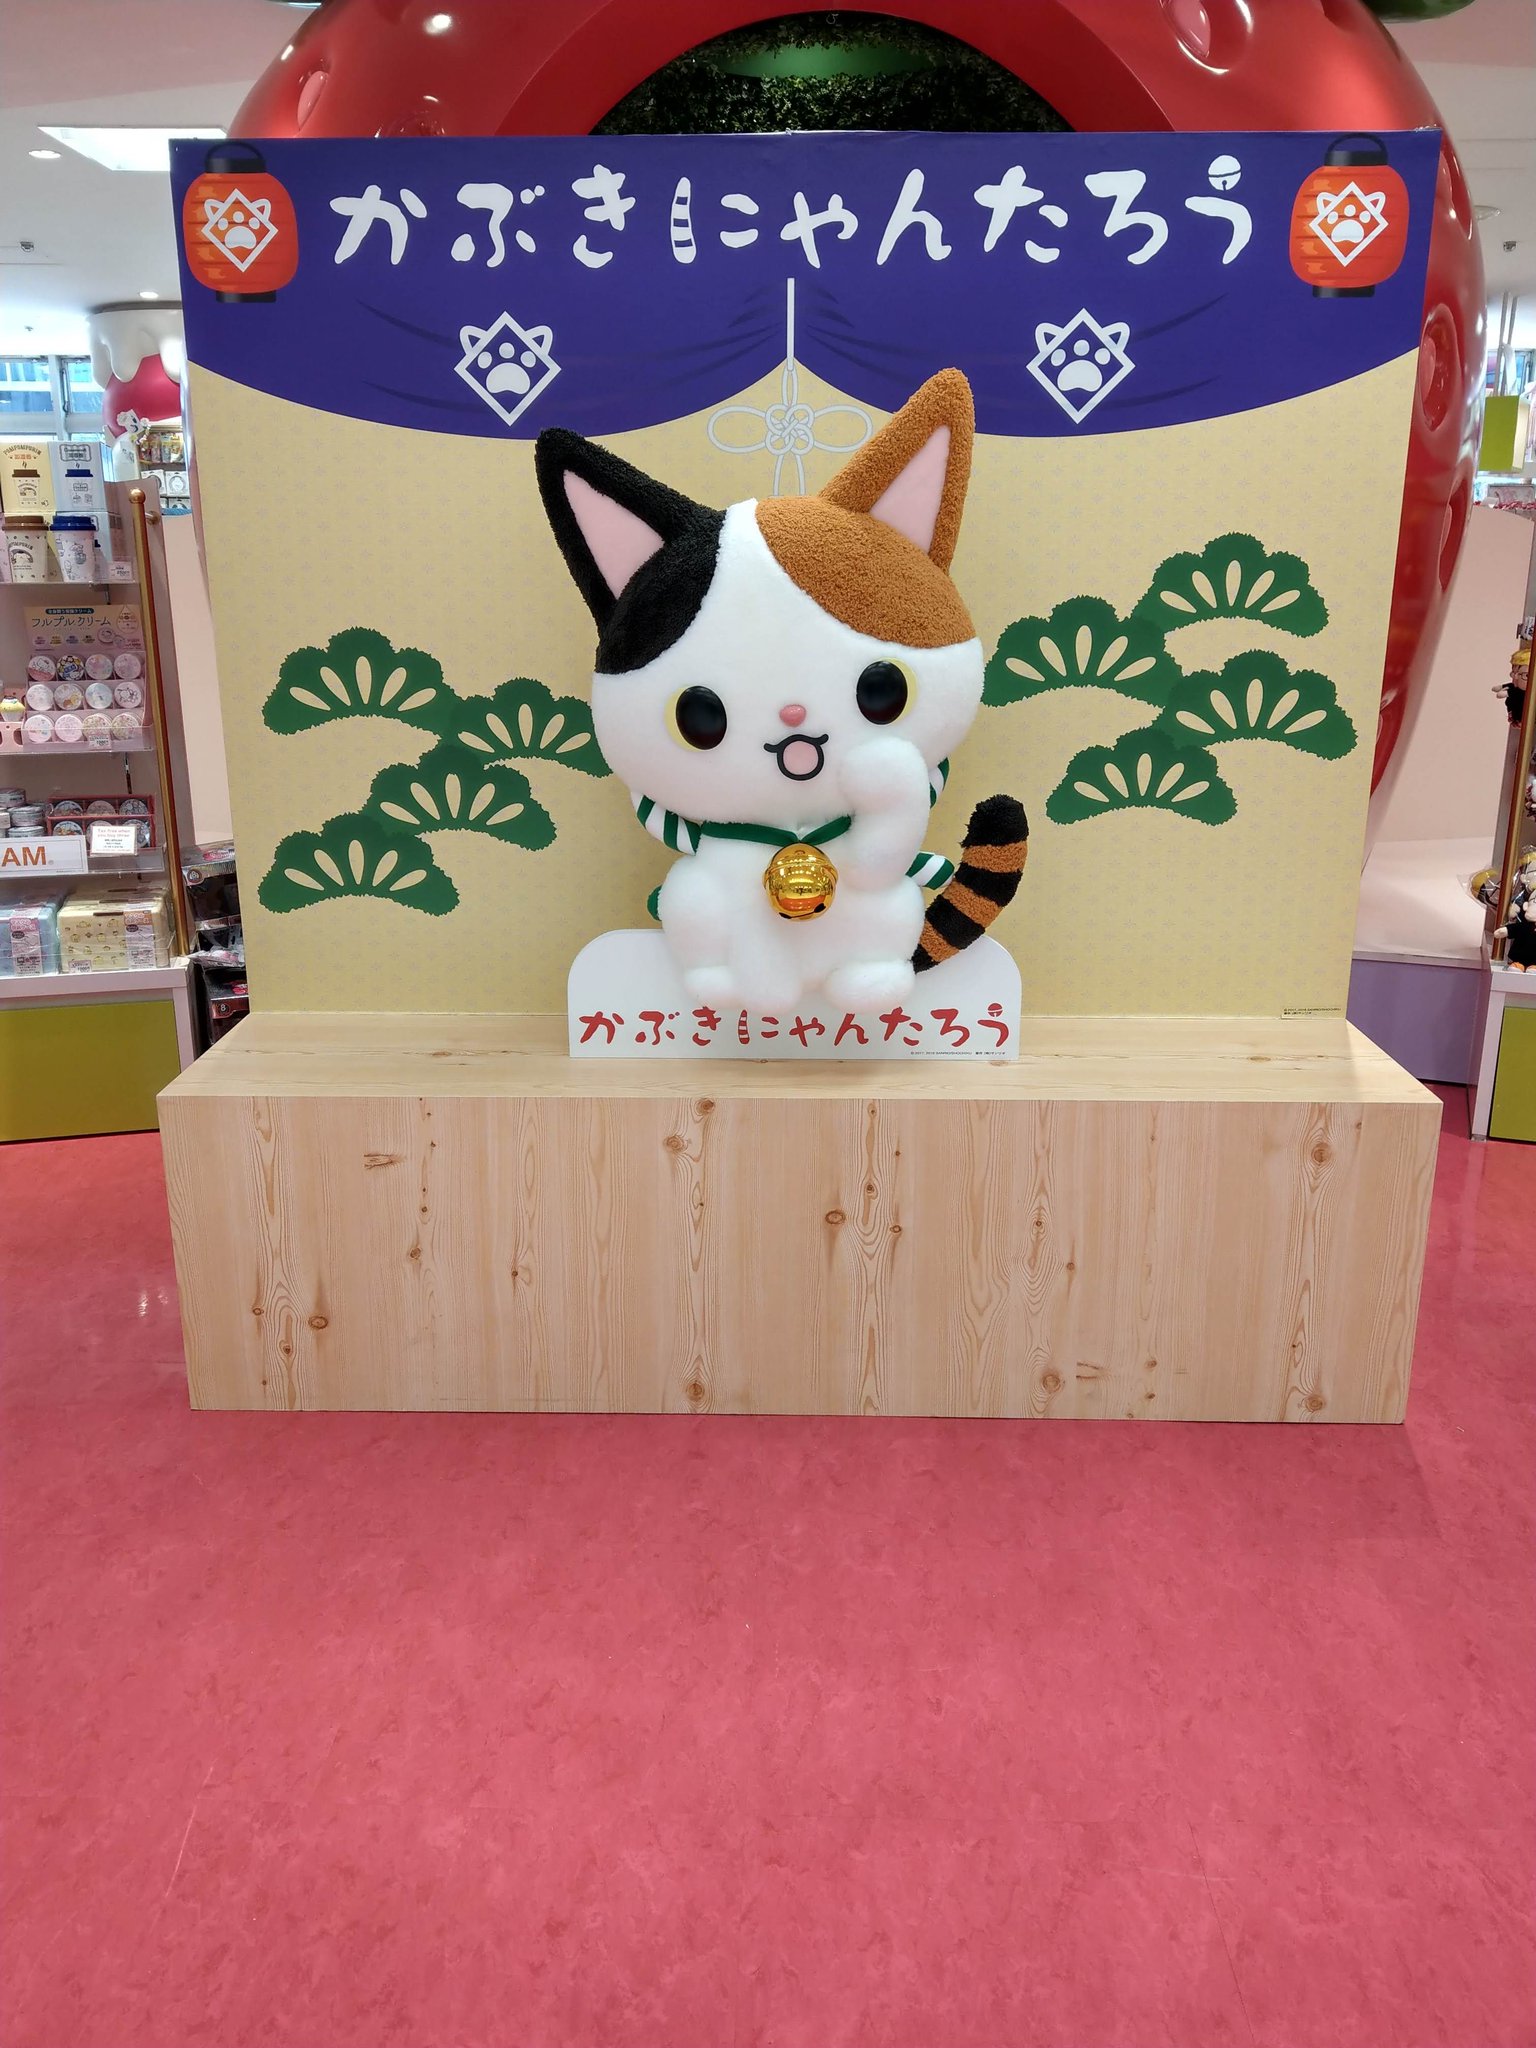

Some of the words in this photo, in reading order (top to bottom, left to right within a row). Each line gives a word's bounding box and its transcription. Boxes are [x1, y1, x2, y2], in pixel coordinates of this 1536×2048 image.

[329, 155, 1253, 267] かぶきにゃんたろう
[579, 1003, 1010, 1047] かぶきにゃんたろう
